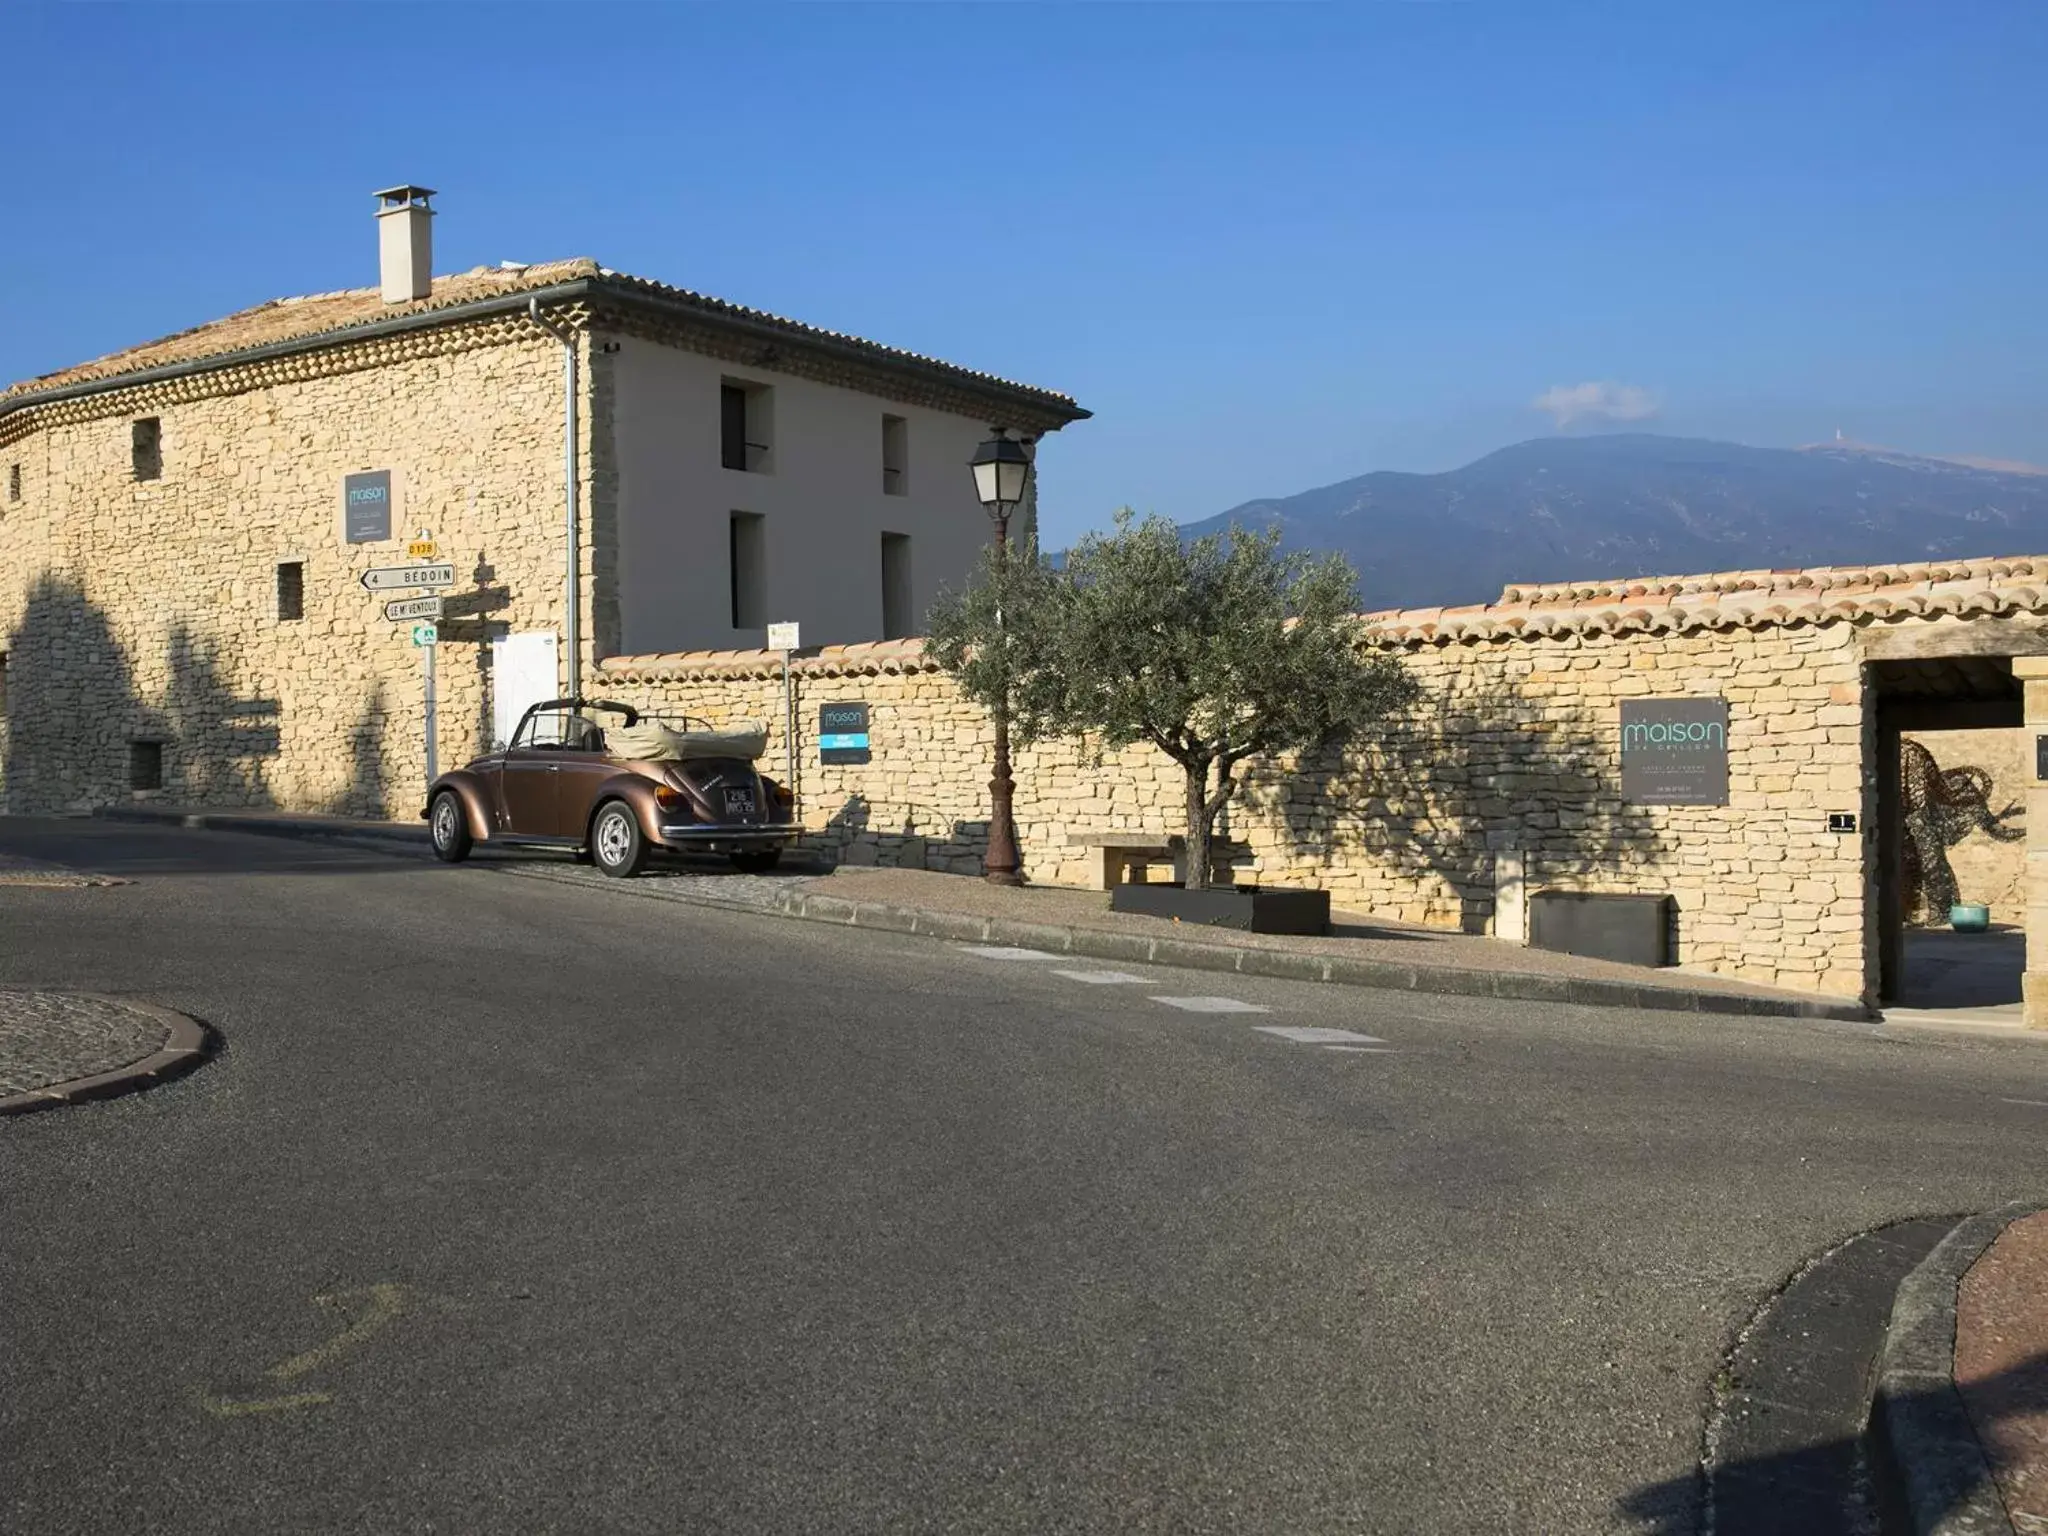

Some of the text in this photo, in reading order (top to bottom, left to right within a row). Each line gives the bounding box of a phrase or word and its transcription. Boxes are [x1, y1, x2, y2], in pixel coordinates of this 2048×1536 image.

[372, 574, 378, 584] 4
[1624, 723, 1723, 751] maison
[1840, 816, 1845, 827] 1
